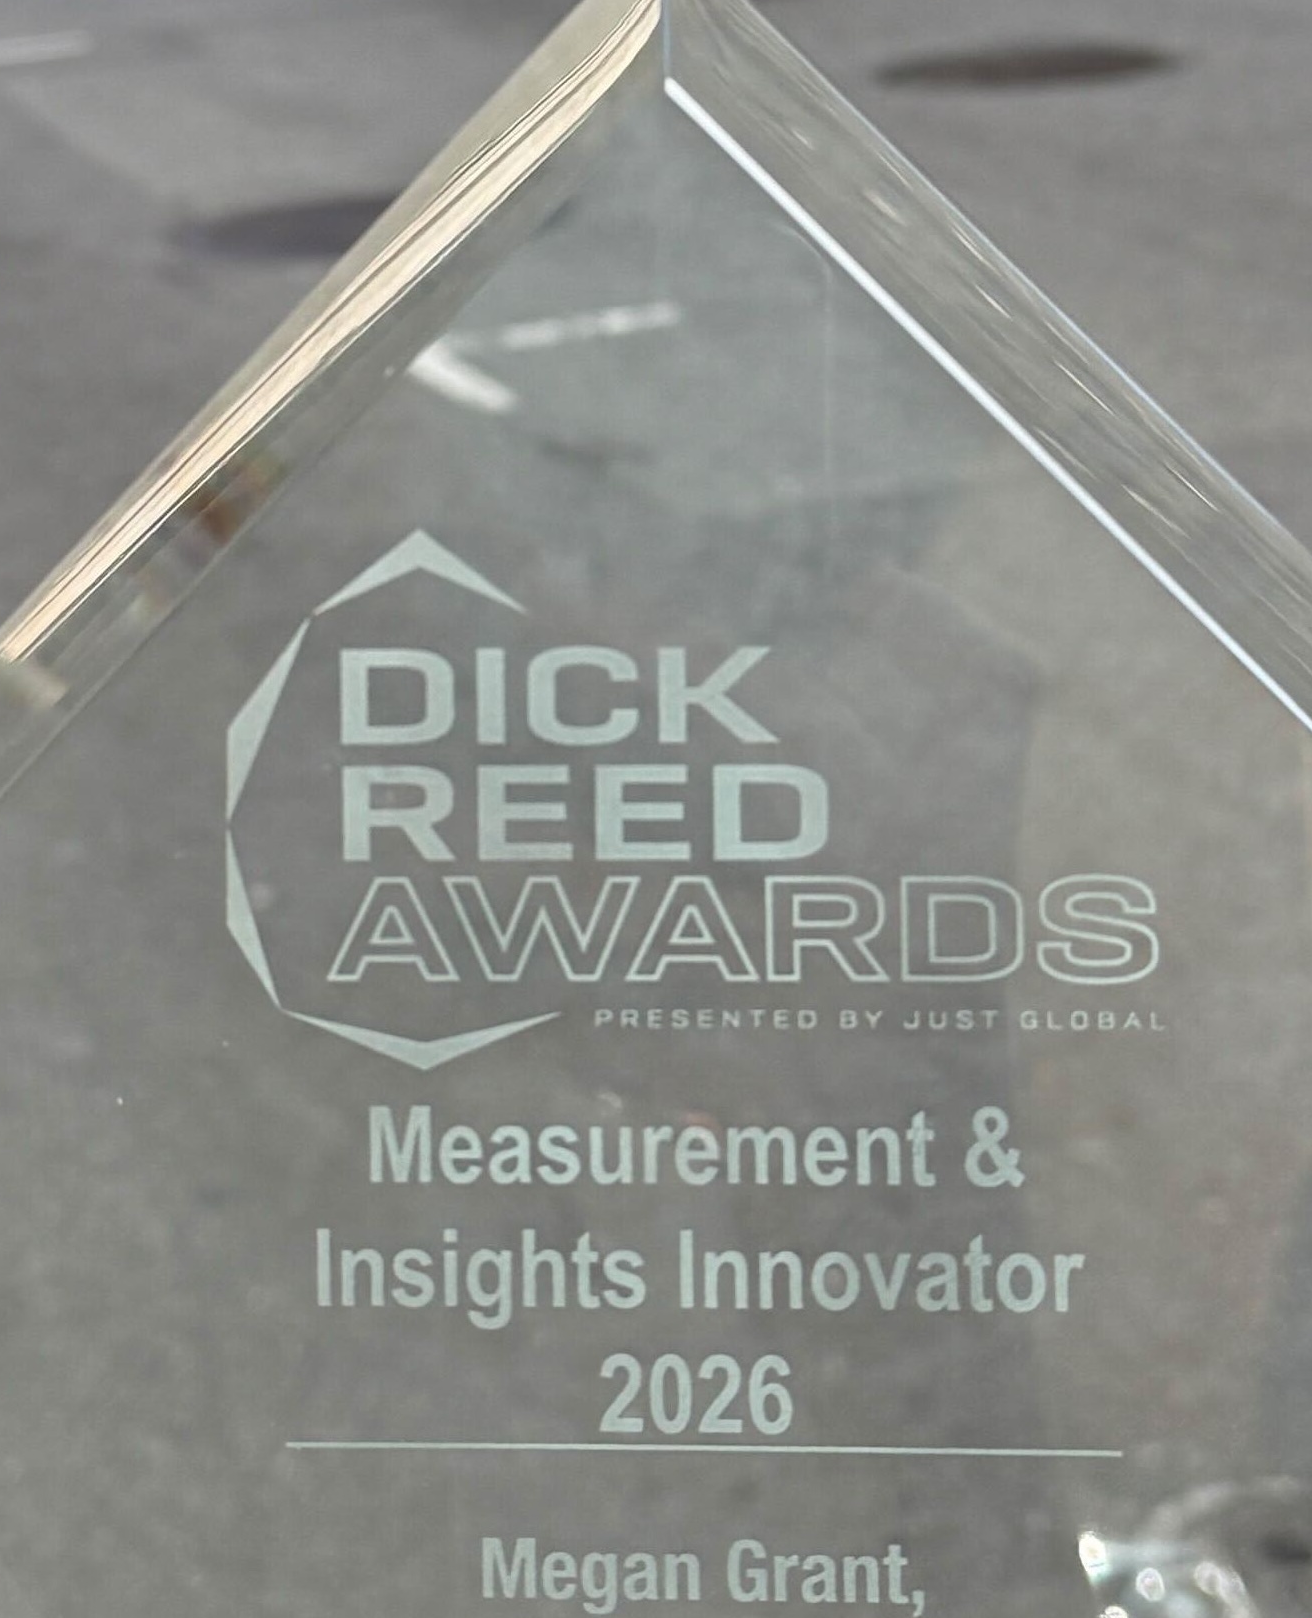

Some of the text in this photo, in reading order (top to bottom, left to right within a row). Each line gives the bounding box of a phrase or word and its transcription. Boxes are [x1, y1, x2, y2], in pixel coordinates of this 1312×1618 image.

[339, 645, 778, 746] DICK
[341, 763, 829, 862] REED
[325, 873, 1160, 986] AWARDS
[593, 1007, 1166, 1032] PRESENTED BY JUST GLOBAL
[369, 1104, 1026, 1188] Measurement &
[316, 1227, 1086, 1330] Insights Innovator
[599, 1353, 794, 1436] 2026
[481, 1536, 925, 1618] Megan Grant,
